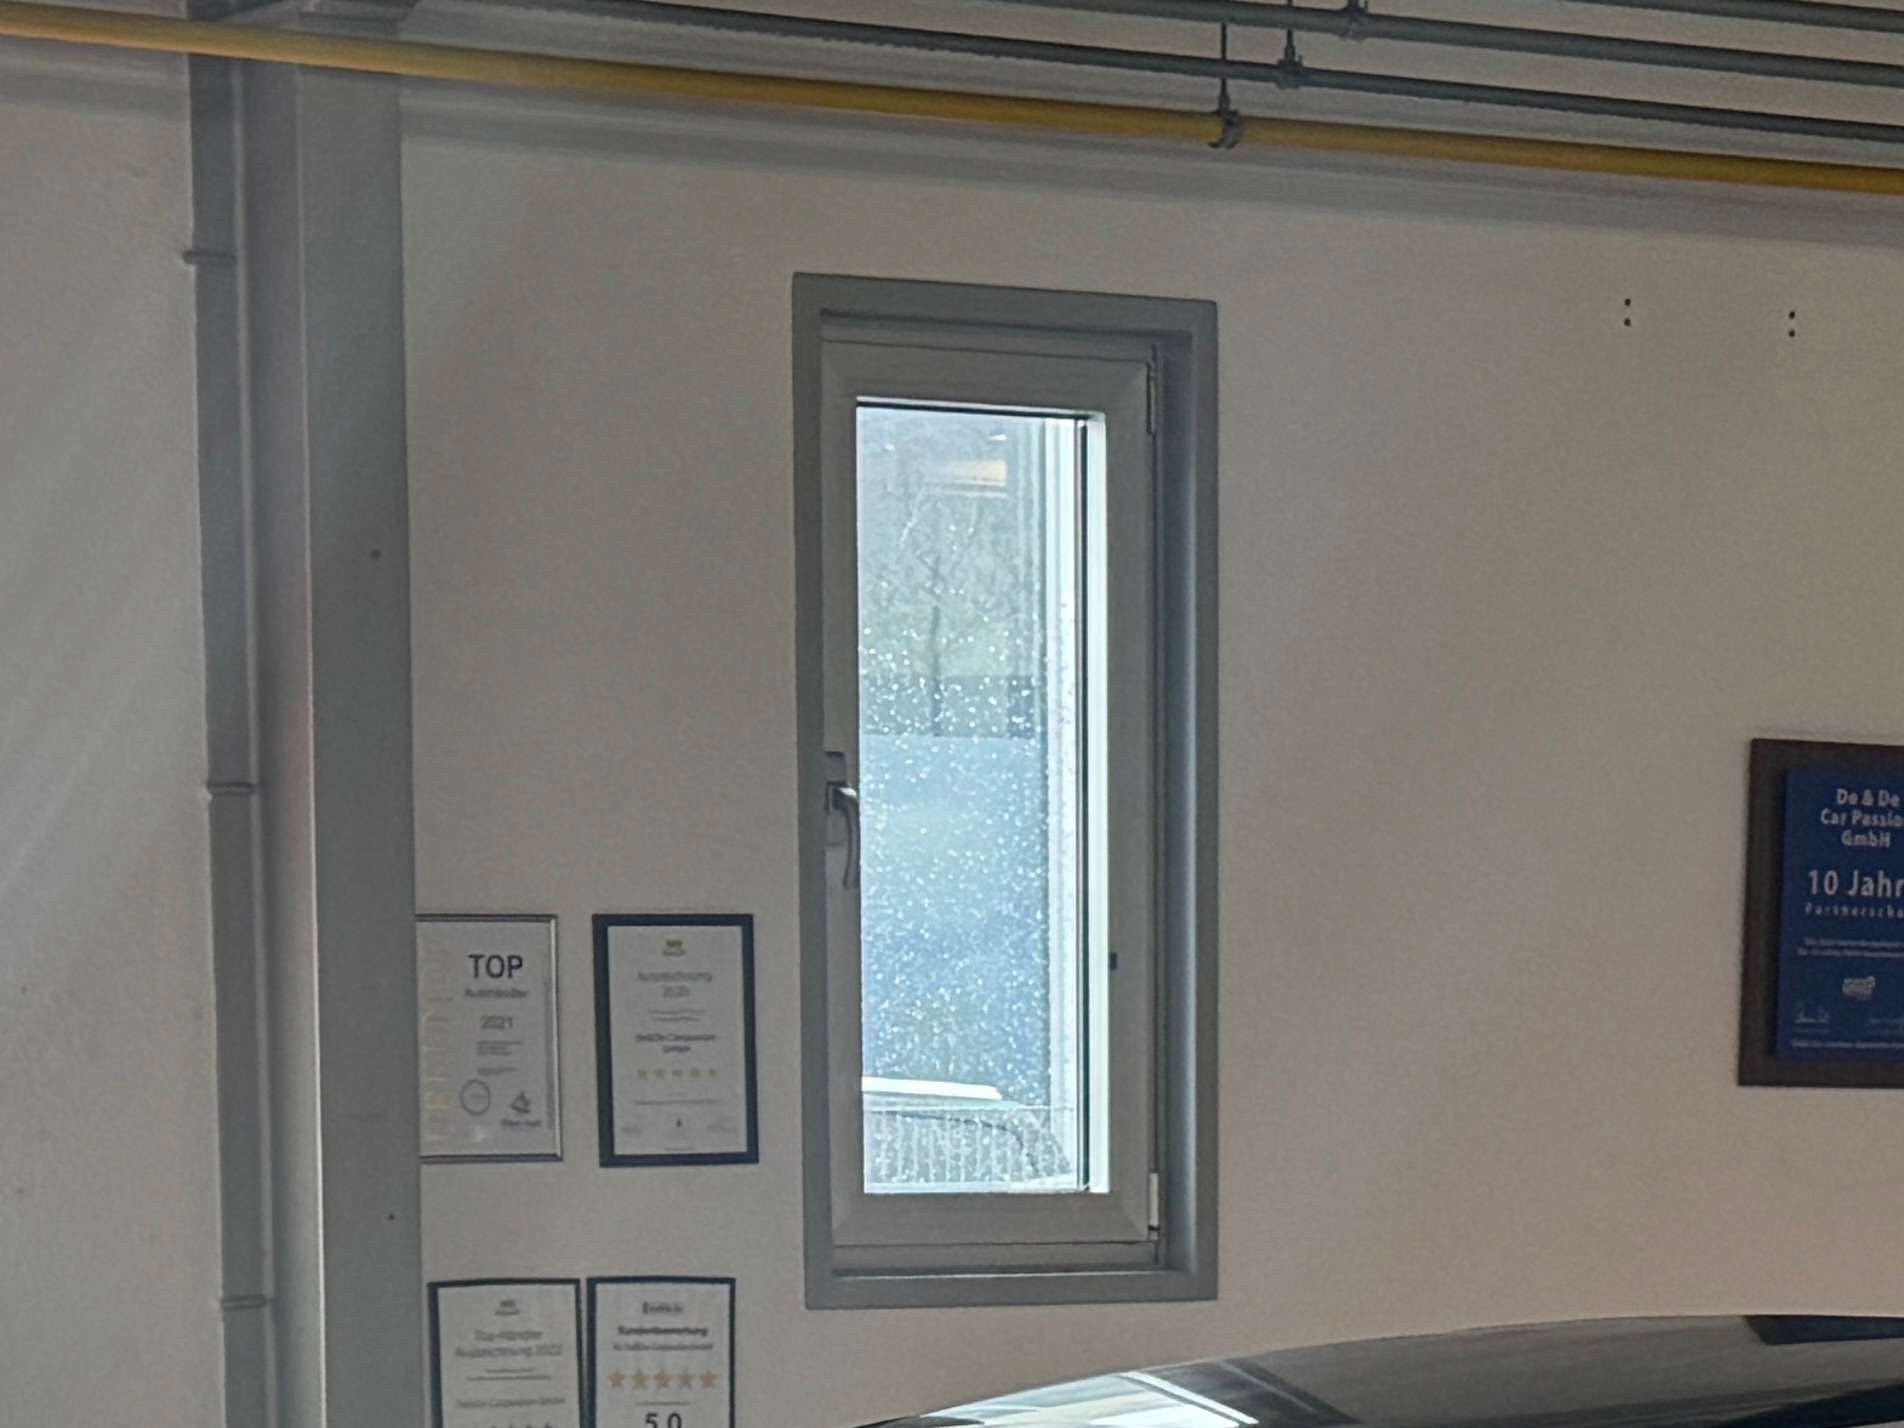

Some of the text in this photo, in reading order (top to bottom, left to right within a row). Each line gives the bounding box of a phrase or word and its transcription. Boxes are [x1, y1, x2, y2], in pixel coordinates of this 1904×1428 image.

[1836, 788, 1858, 806] De
[1877, 789, 1900, 808] De
[1820, 807, 1847, 826] Car
[1841, 829, 1891, 848] GmbH
[1809, 869, 1839, 896] 10
[467, 953, 523, 979] TOP
